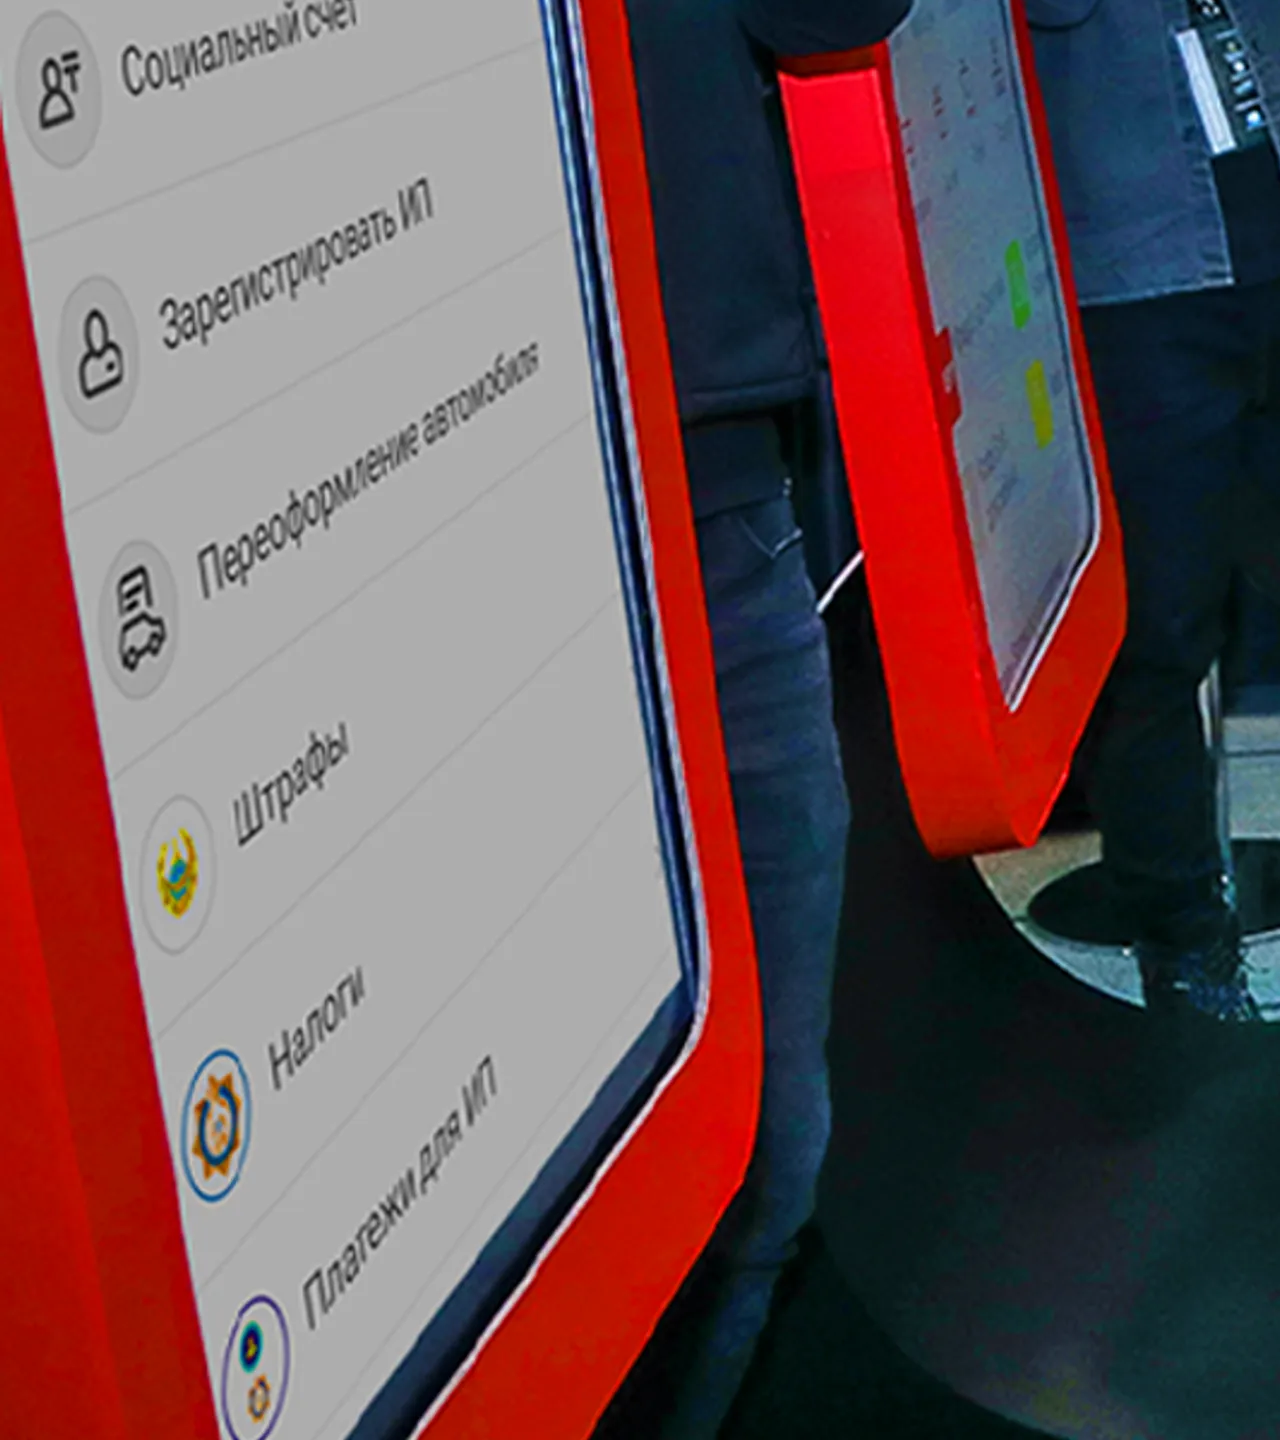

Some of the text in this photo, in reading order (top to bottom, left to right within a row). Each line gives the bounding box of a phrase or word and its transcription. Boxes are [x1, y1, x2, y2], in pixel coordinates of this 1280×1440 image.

[157, 176, 434, 351] Зарегистрировать ИП
[196, 342, 539, 601] Переоформление автомобиля
[232, 721, 350, 848] Штрафы
[267, 966, 366, 1092] Налоги
[302, 1054, 499, 1332] Платежи для ИП
